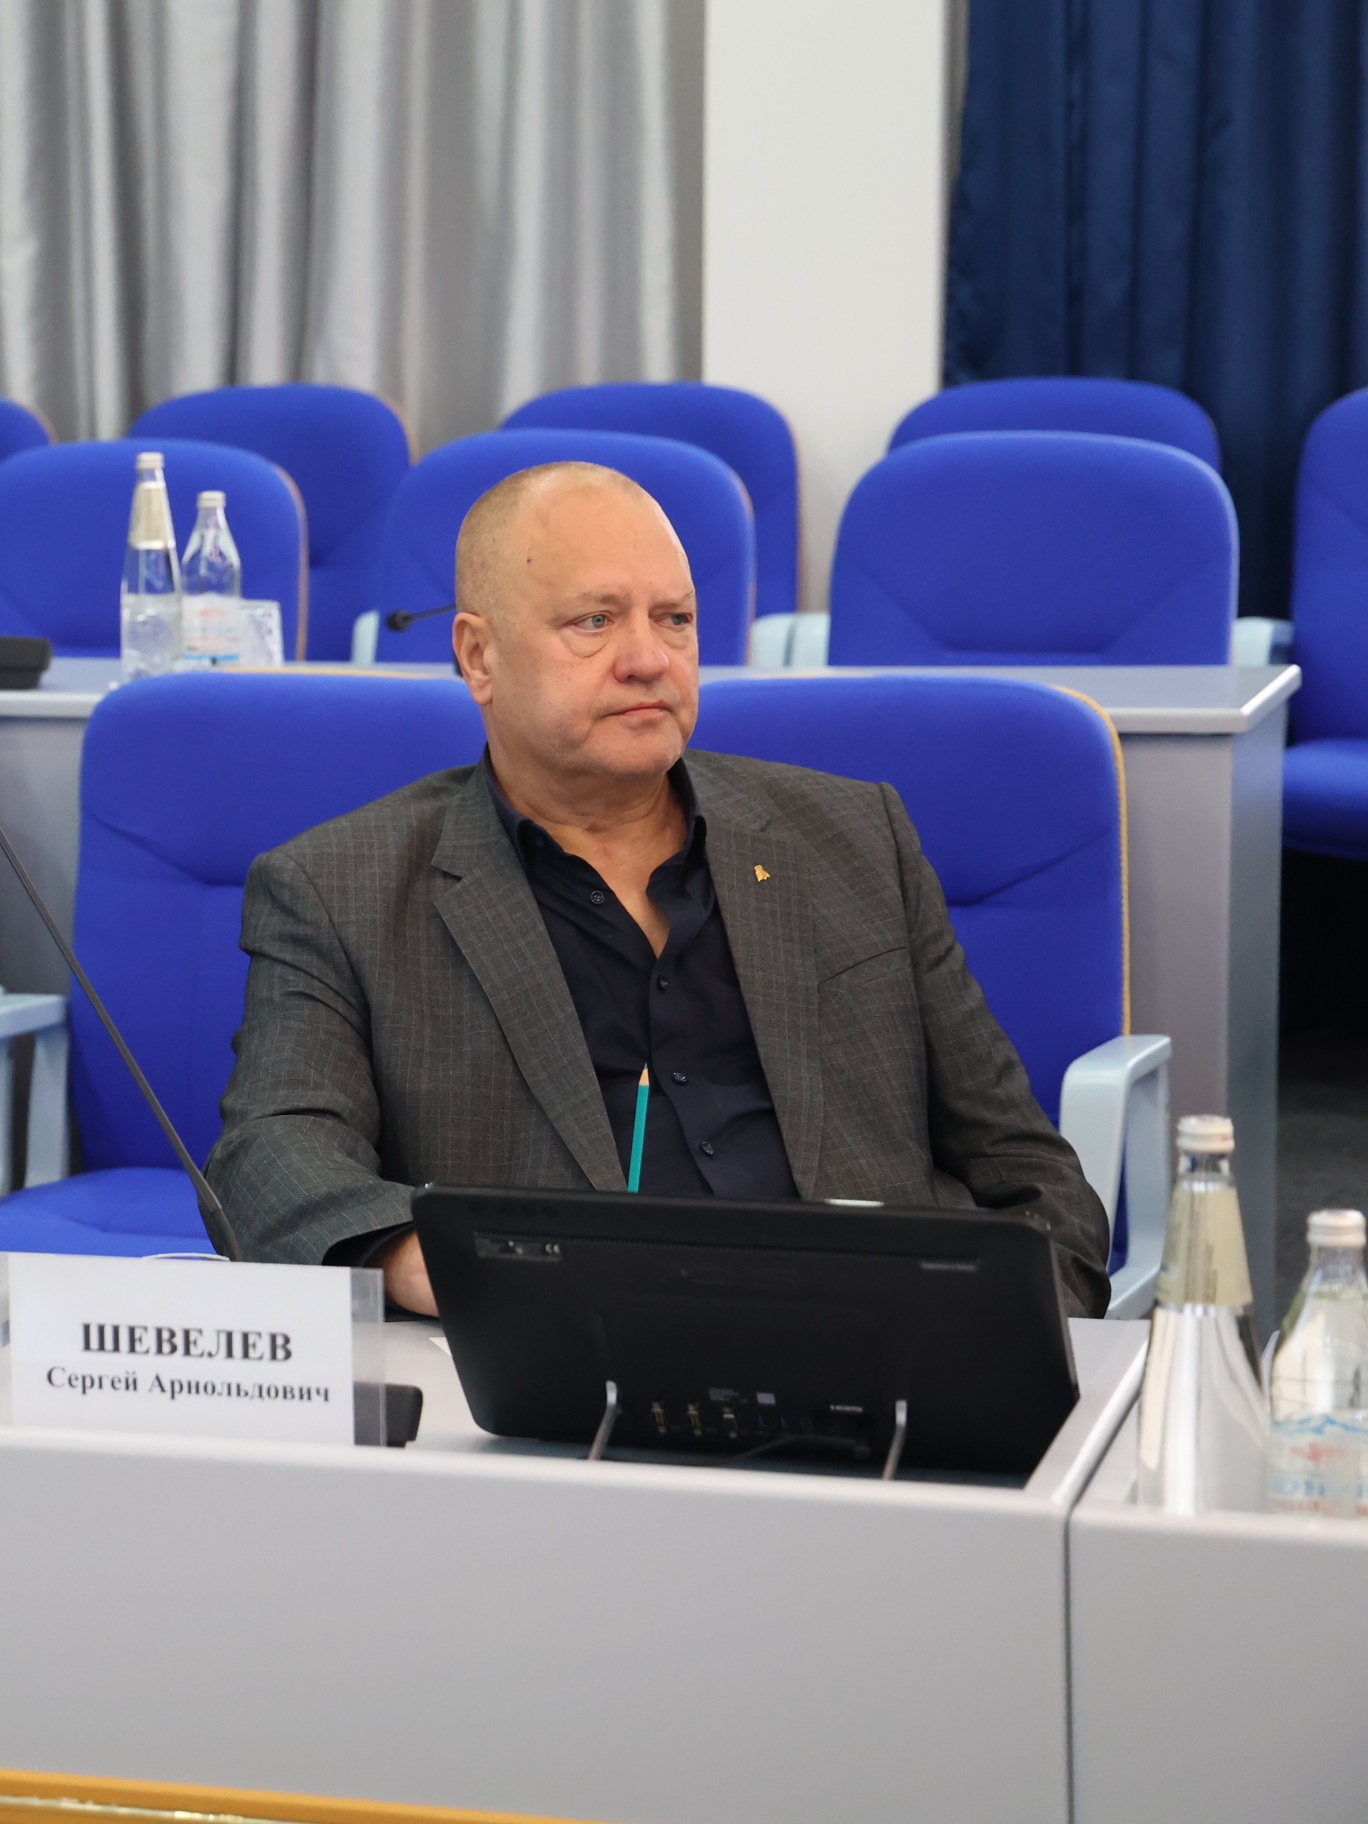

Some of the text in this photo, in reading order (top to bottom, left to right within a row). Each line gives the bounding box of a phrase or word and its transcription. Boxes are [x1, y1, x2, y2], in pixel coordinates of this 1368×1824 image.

[81, 1322, 293, 1362] ШЕВЕЛЕВ
[45, 1365, 330, 1402] Сергей Арнольдович
